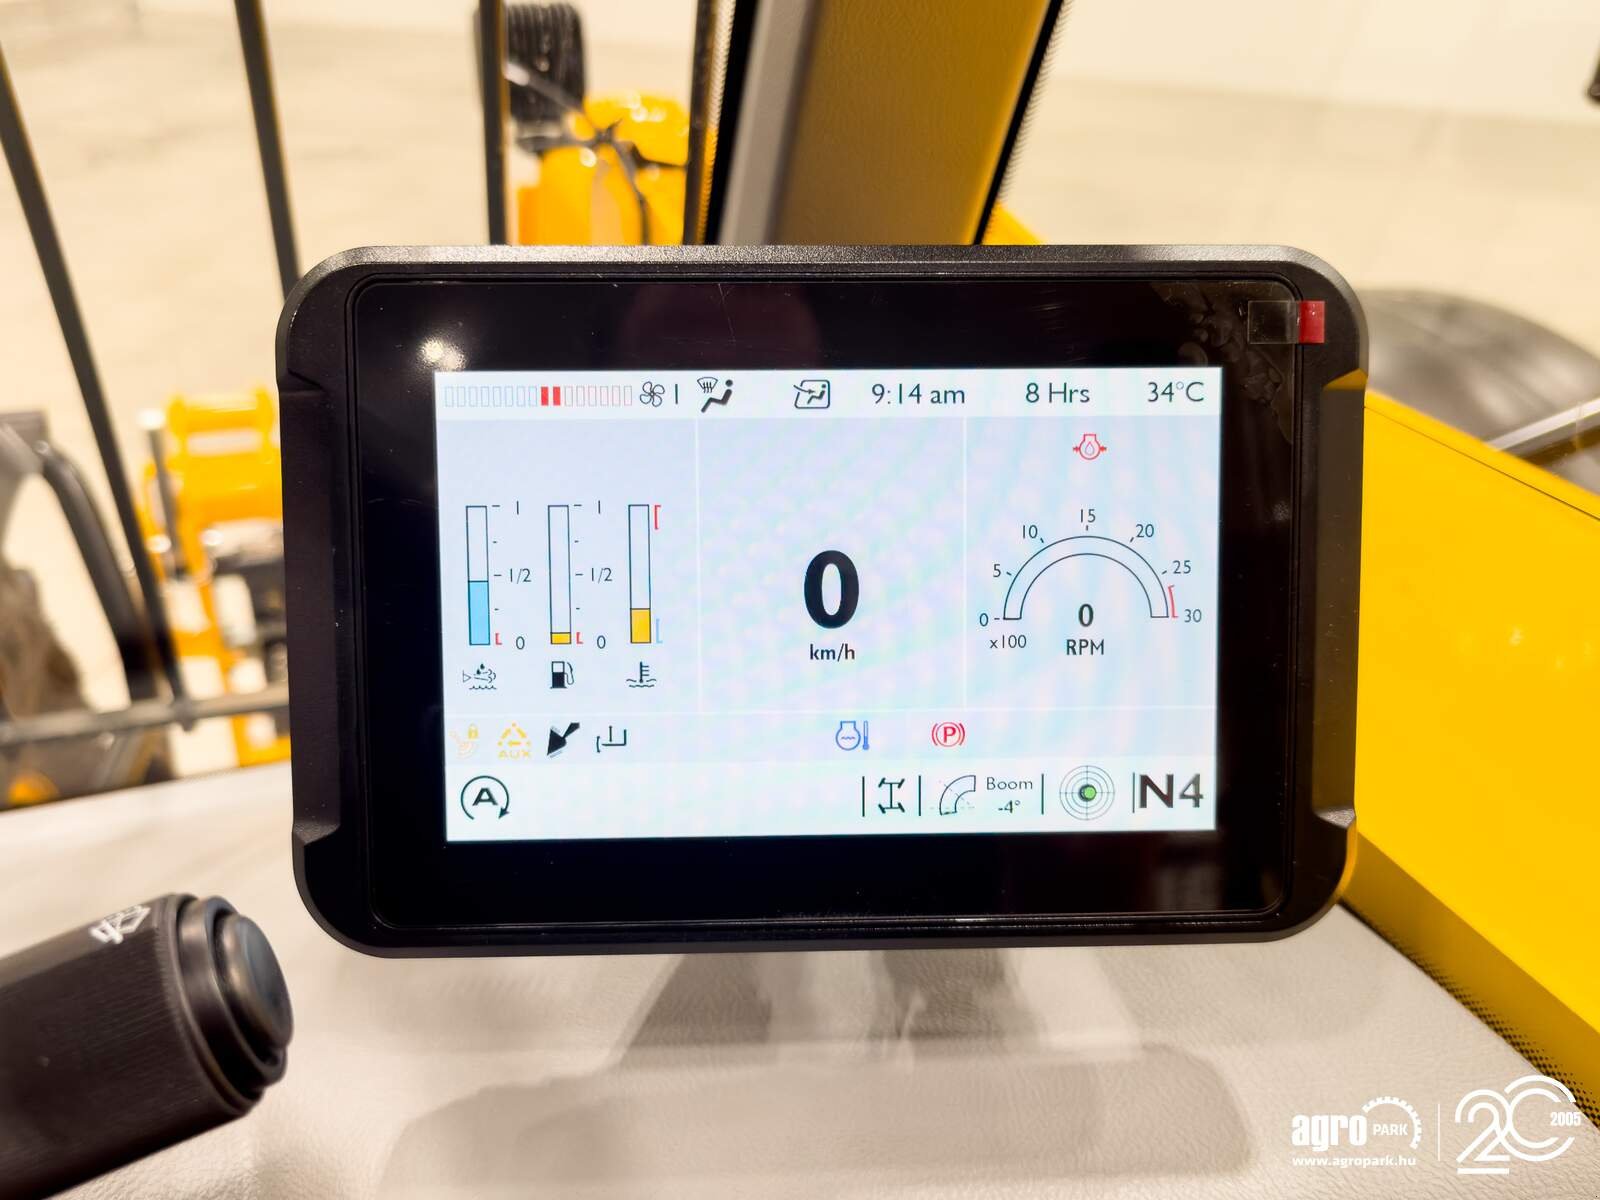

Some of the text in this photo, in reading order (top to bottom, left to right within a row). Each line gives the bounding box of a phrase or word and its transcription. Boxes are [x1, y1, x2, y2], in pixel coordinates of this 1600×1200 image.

[871, 383, 965, 405] 9:14 am
[1025, 382, 1090, 404] 8 Hrs
[1148, 381, 1204, 403] 34°C
[1080, 508, 1096, 524] 15
[1022, 524, 1038, 539] 10
[1135, 523, 1155, 538] 20
[591, 567, 613, 582] 1/2
[993, 563, 1002, 578] 5
[1172, 559, 1192, 575] 25
[509, 568, 531, 583] 1/2
[803, 549, 860, 630] 0
[979, 612, 989, 627] 0
[1078, 603, 1094, 628] 0
[1184, 608, 1202, 623] 30
[515, 635, 526, 651] 0
[596, 635, 607, 650] 0
[989, 634, 1027, 649] x100
[1066, 638, 1105, 656] RPM
[809, 643, 855, 662] km/h
[986, 776, 1033, 791] Boom
